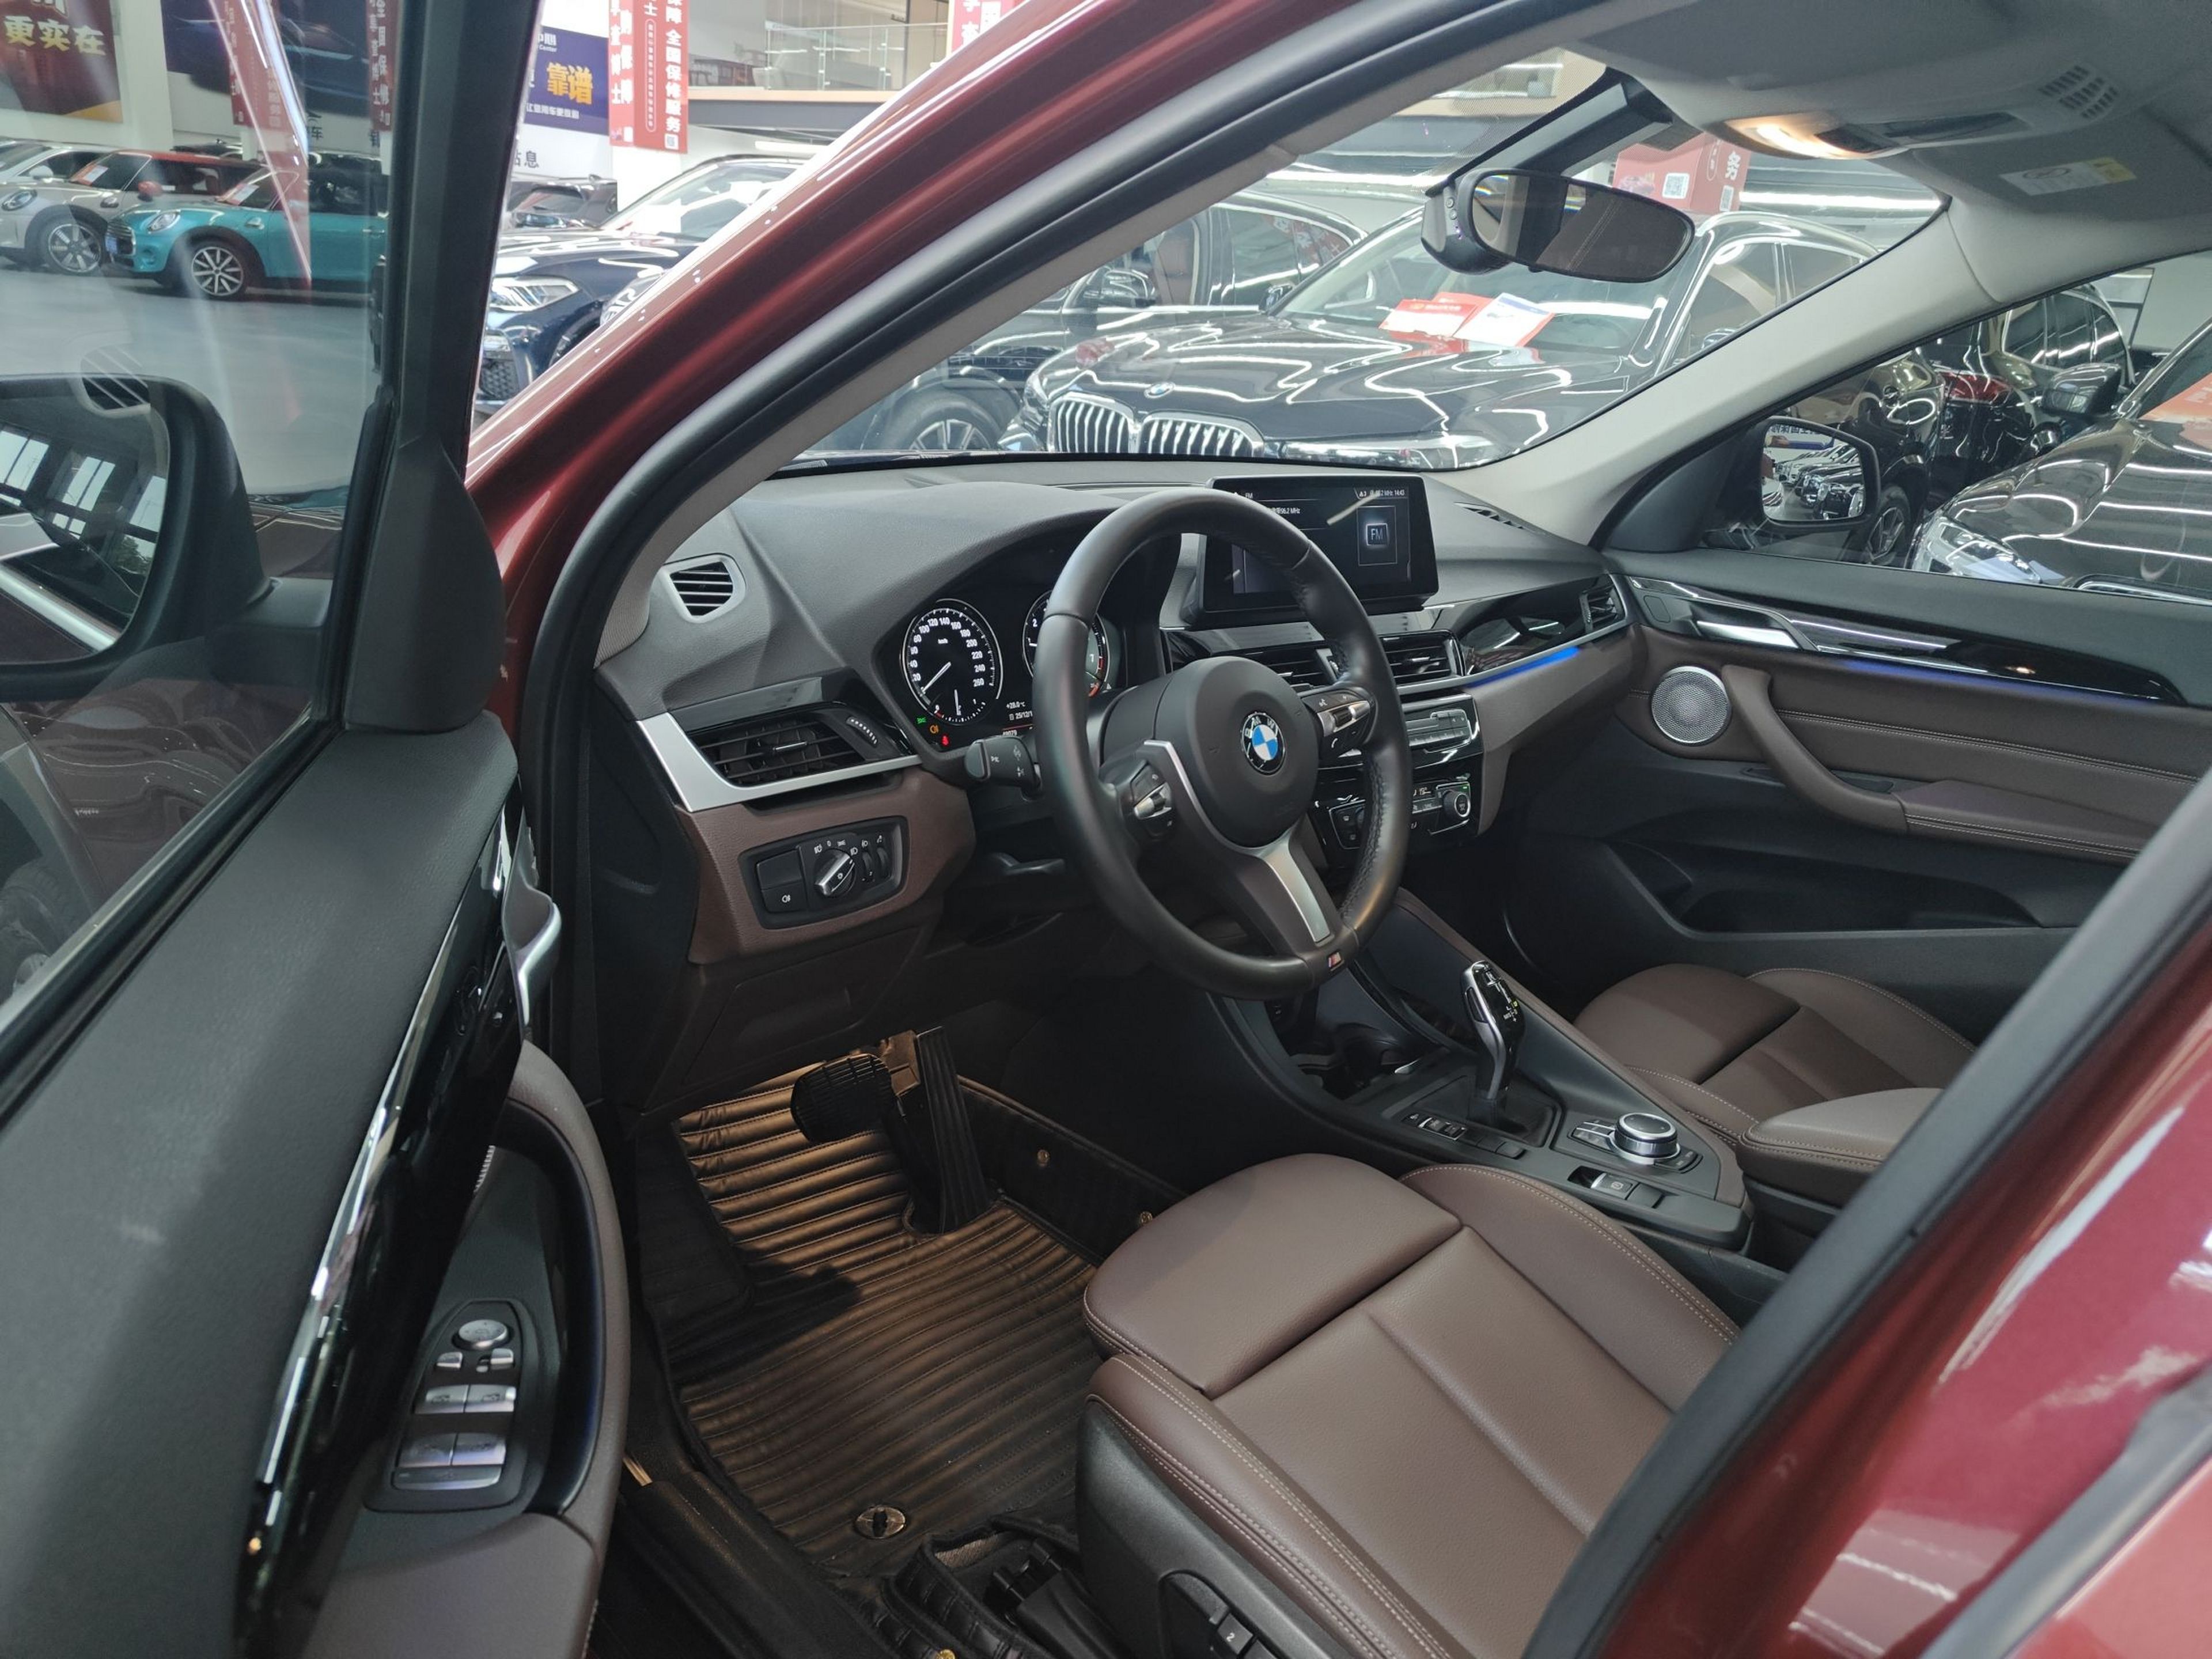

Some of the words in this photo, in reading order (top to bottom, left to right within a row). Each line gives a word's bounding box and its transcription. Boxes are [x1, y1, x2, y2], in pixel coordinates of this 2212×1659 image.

[643, 0, 658, 16] 士
[4, 16, 106, 55] 更实在
[547, 62, 593, 105] 靠谱
[665, 29, 682, 132] 全国保修服务
[1371, 528, 1383, 540] FM
[927, 618, 938, 627] 120
[939, 617, 950, 626] 140
[1032, 618, 1037, 627] 2
[918, 624, 930, 634] 100
[965, 639, 978, 647] 200
[971, 651, 983, 660] 220
[1089, 654, 1094, 662] 7
[910, 660, 918, 668] 40
[974, 664, 986, 673] 240
[912, 673, 921, 681] 20
[972, 678, 984, 687] 260
[1244, 715, 1275, 738] BMW
[1226, 1632, 1235, 1642] 2
